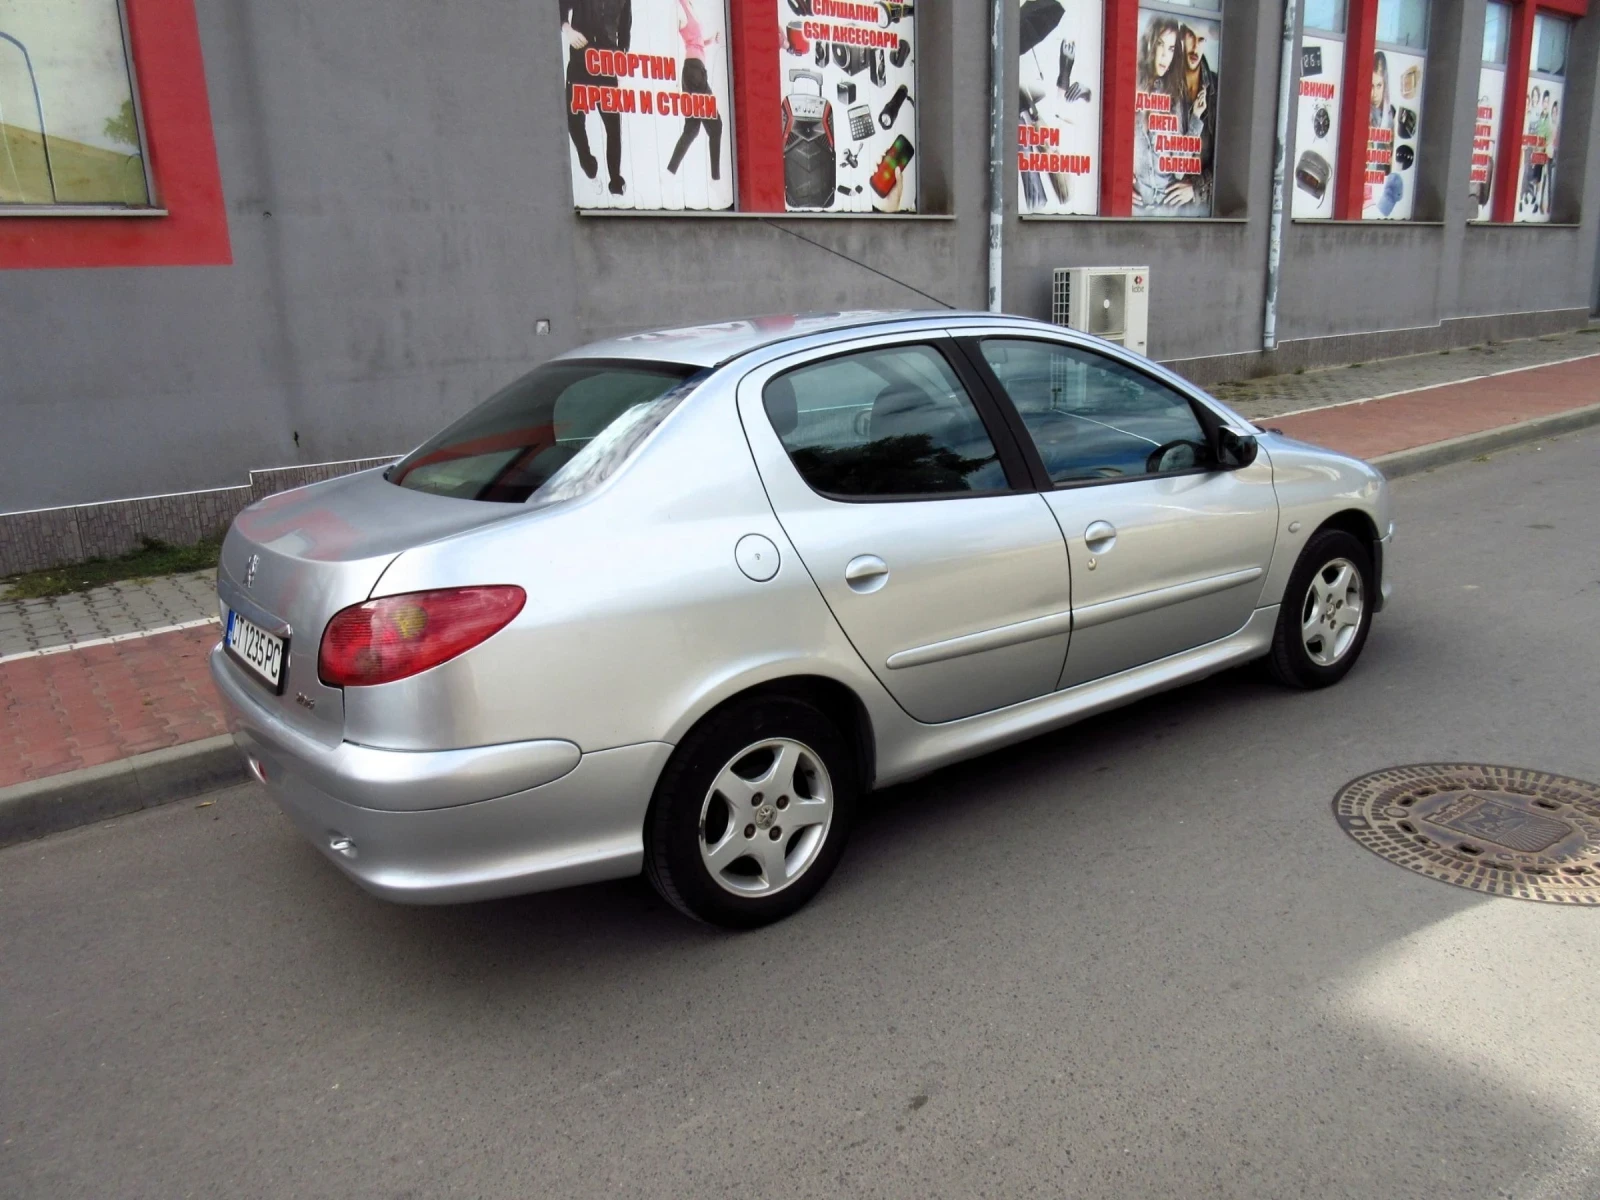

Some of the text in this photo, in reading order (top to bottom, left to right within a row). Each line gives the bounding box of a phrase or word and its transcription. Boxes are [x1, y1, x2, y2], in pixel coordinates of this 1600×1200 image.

[813, 0, 879, 23] СЛУШАЛКИ
[803, 21, 898, 49] GSM АКСЕСОАРИ
[586, 49, 676, 80] СПОРТНИ
[572, 85, 717, 118] ДРЕХИ И СТОКИ
[1136, 92, 1171, 111] ДЪНКИ
[1149, 115, 1178, 131] ЯКЕТА
[1156, 135, 1202, 152] ДЪНКОВИ
[1159, 157, 1201, 173] ОБЛЕКЛА
